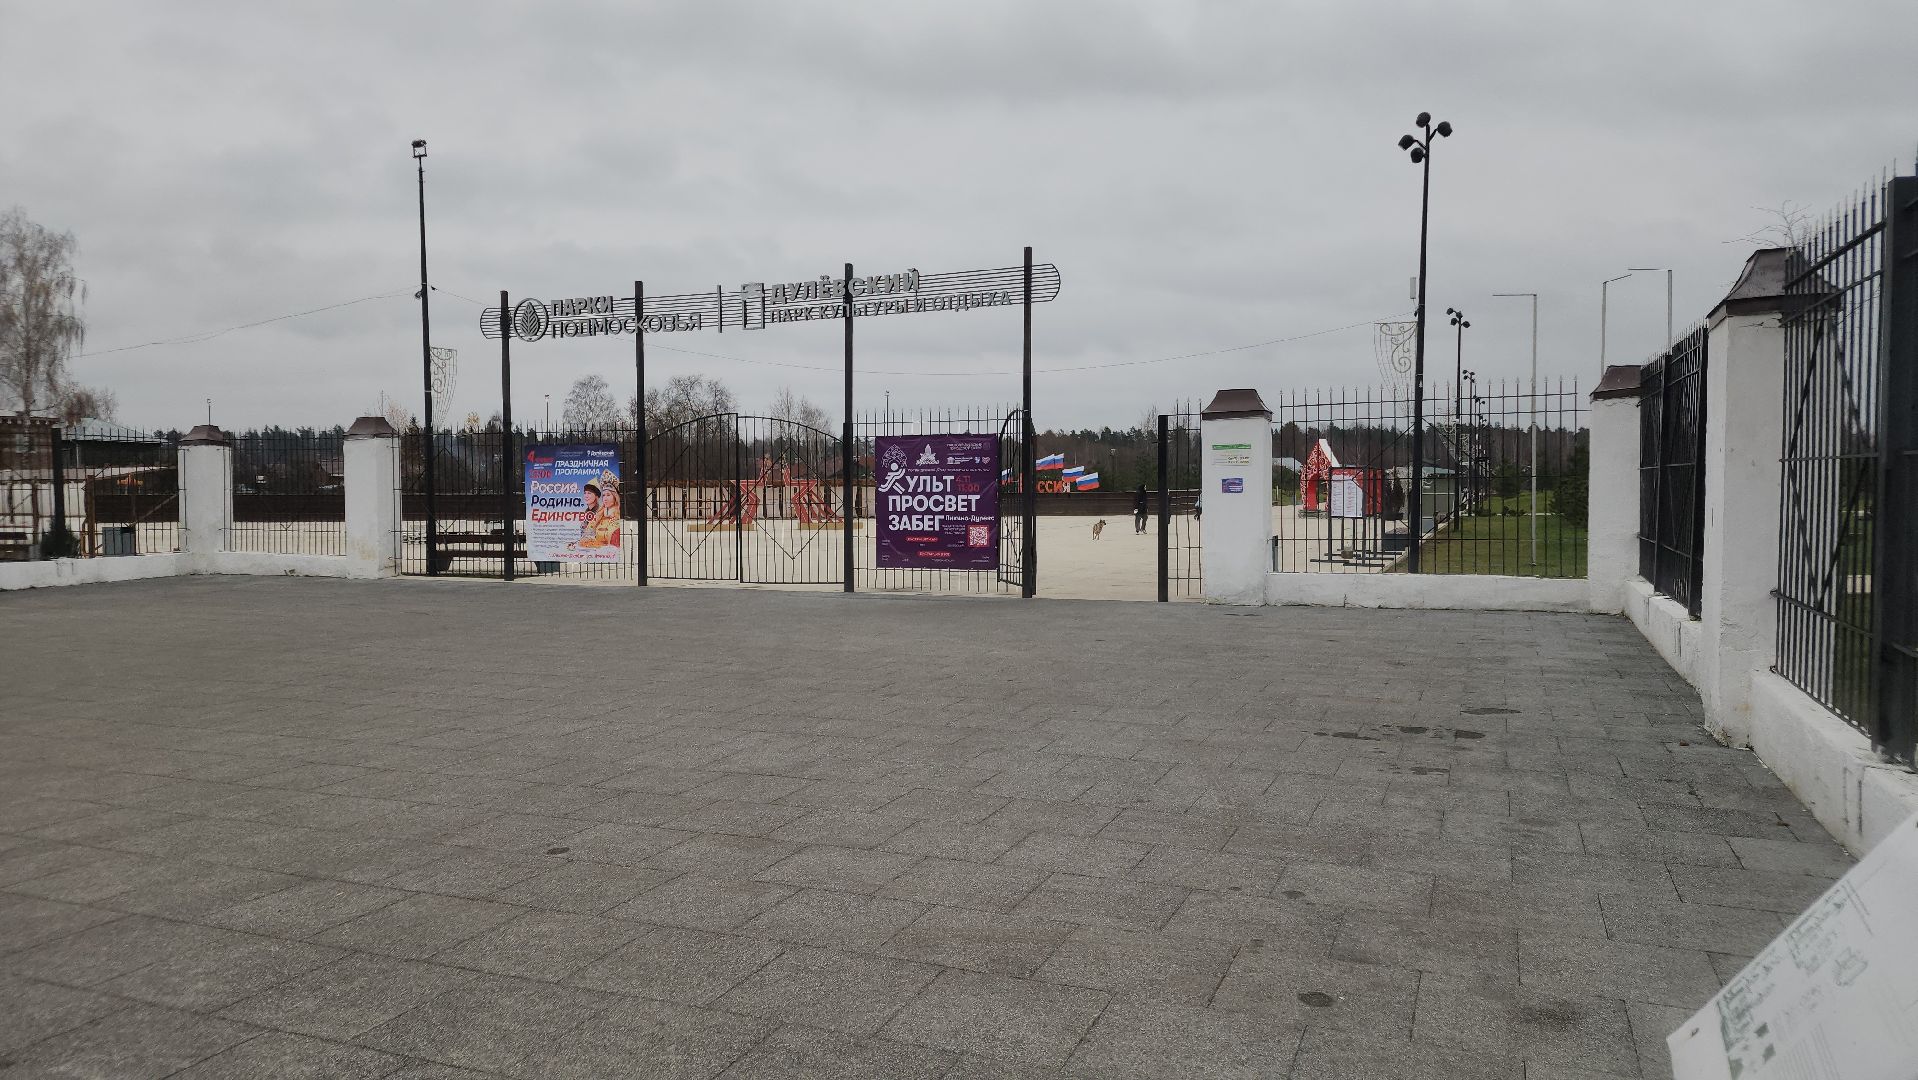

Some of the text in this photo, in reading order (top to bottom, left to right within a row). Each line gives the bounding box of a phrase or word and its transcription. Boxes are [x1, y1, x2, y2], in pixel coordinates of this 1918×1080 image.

[770, 267, 920, 305] ДУЛЁВСКИЙ
[550, 295, 614, 317] ПАРКИ
[770, 290, 1013, 323] ПАРК КУЛЬТУРЫ И ОТДЫХА
[550, 313, 702, 339] ПОДМОСКОВЬЯ
[554, 459, 609, 468] ПРАЗДНИЧНАЯ
[555, 468, 601, 476] ПРОГРАММА
[530, 480, 581, 494] Россия.
[531, 494, 585, 509] Родина.
[888, 494, 980, 512] ПРОСВЕТ
[531, 508, 597, 523] Единство.
[888, 514, 945, 531] ЗАБЕГ
